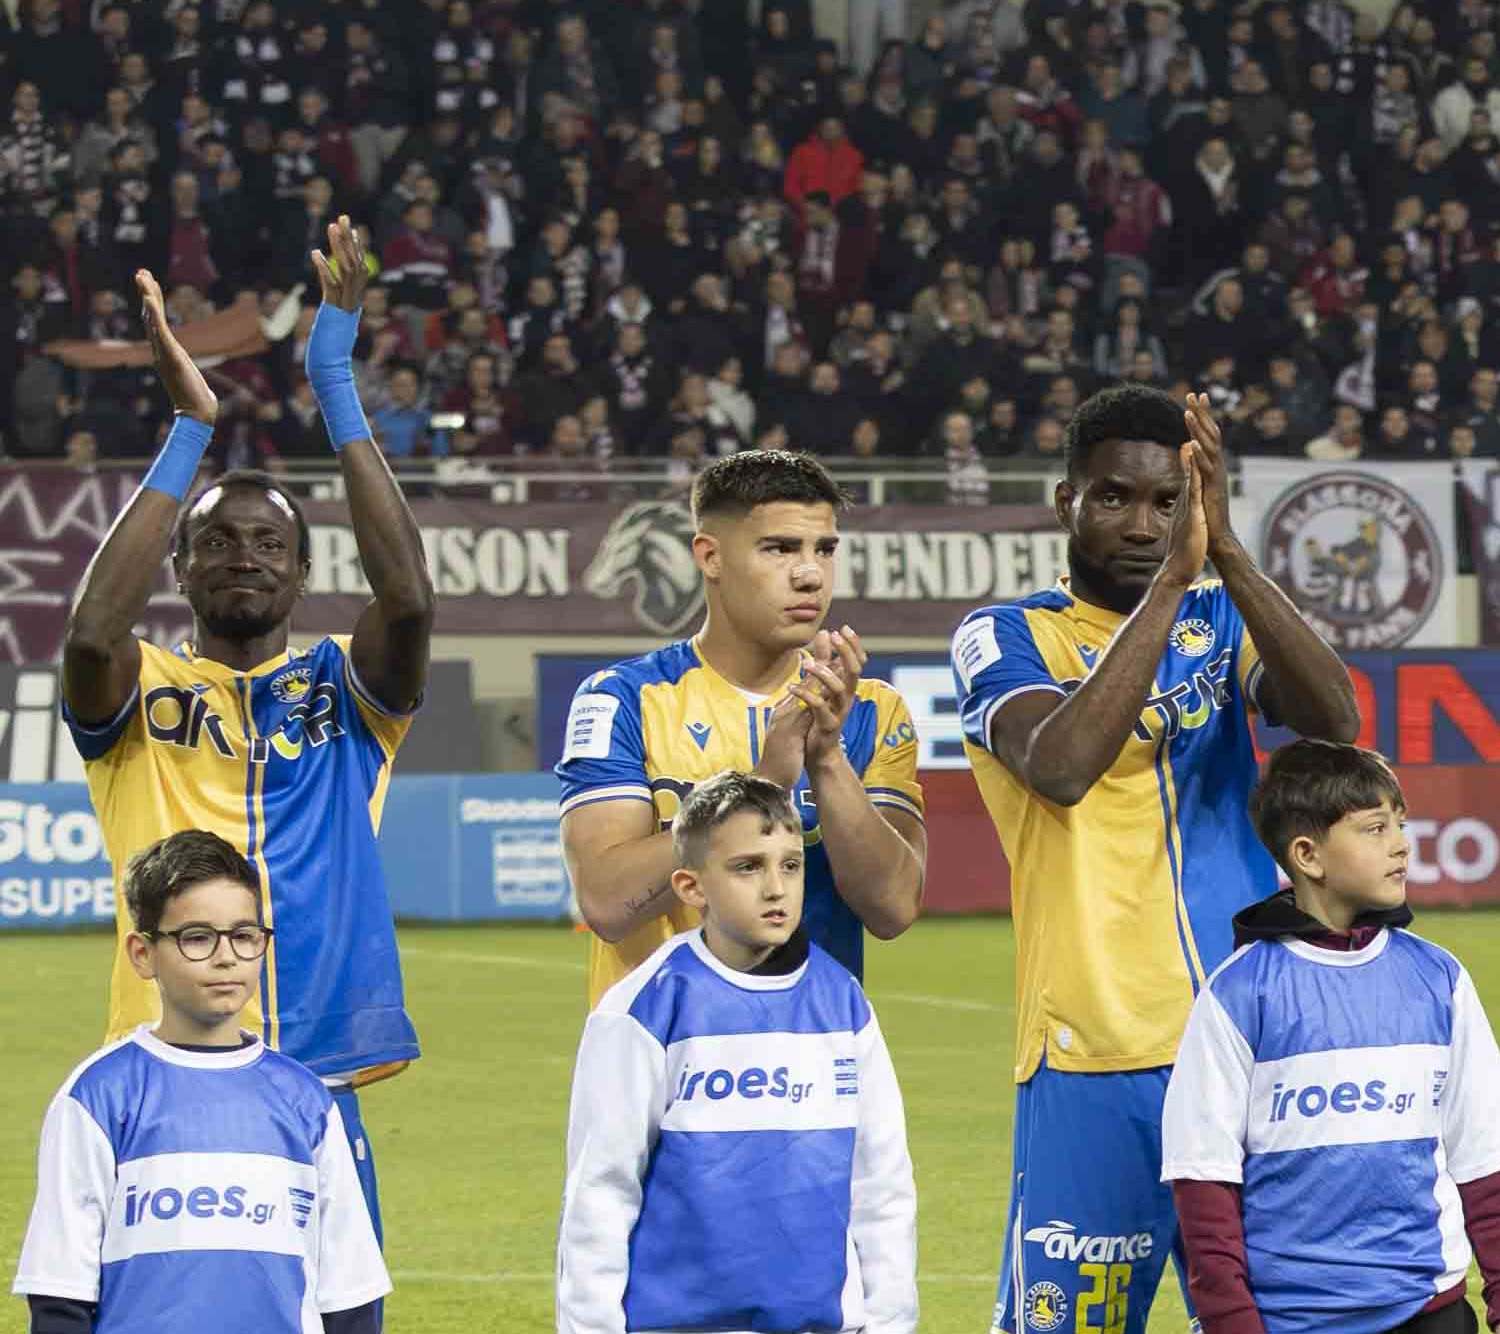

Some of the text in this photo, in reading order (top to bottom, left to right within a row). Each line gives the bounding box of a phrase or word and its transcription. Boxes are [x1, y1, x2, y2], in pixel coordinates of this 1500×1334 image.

[679, 1062, 814, 1104] iroes.gr
[1269, 1079, 1415, 1123] iroes.gr
[125, 1184, 278, 1228] iroes.gr
[1043, 1230, 1153, 1263] avance
